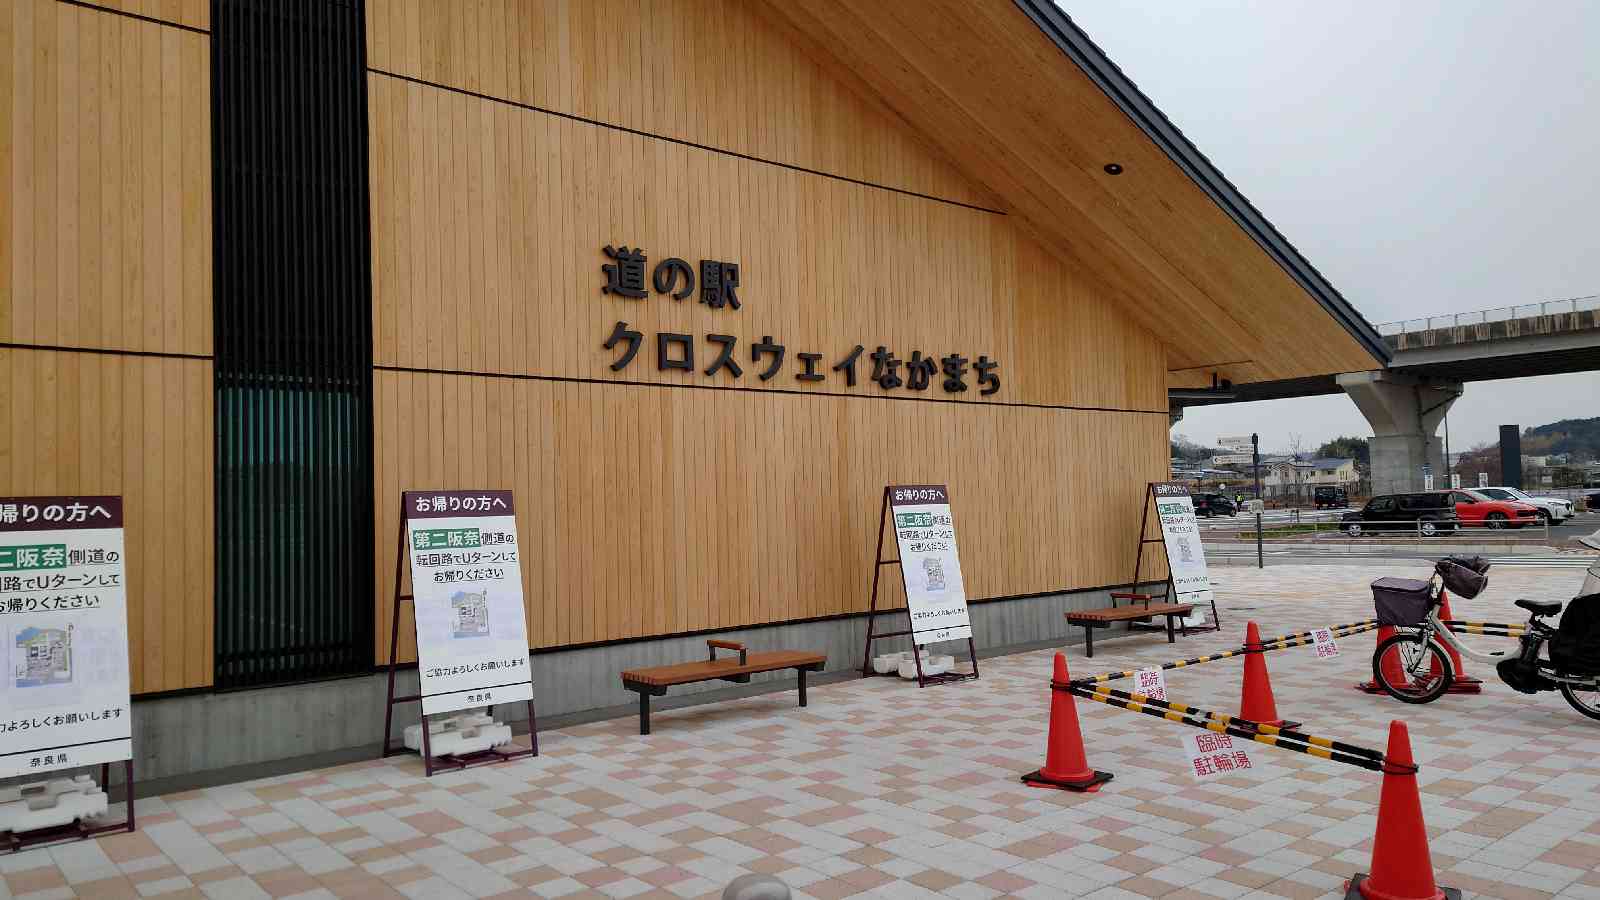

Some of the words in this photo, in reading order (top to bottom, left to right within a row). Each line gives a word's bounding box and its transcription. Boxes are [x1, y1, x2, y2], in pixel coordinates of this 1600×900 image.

[601, 245, 742, 310] 道の駅
[602, 320, 1001, 396] クロスウェイなかまち
[895, 488, 945, 501] お帰りの方へ
[415, 495, 507, 512] お帰りの方へ
[416, 551, 517, 567] 転回路でUターンして
[0, 574, 120, 592] 路でUターンして
[433, 568, 504, 582] お帰りください
[30, 753, 68, 768] 奈良県
[1194, 751, 1252, 776] 駐輪場
